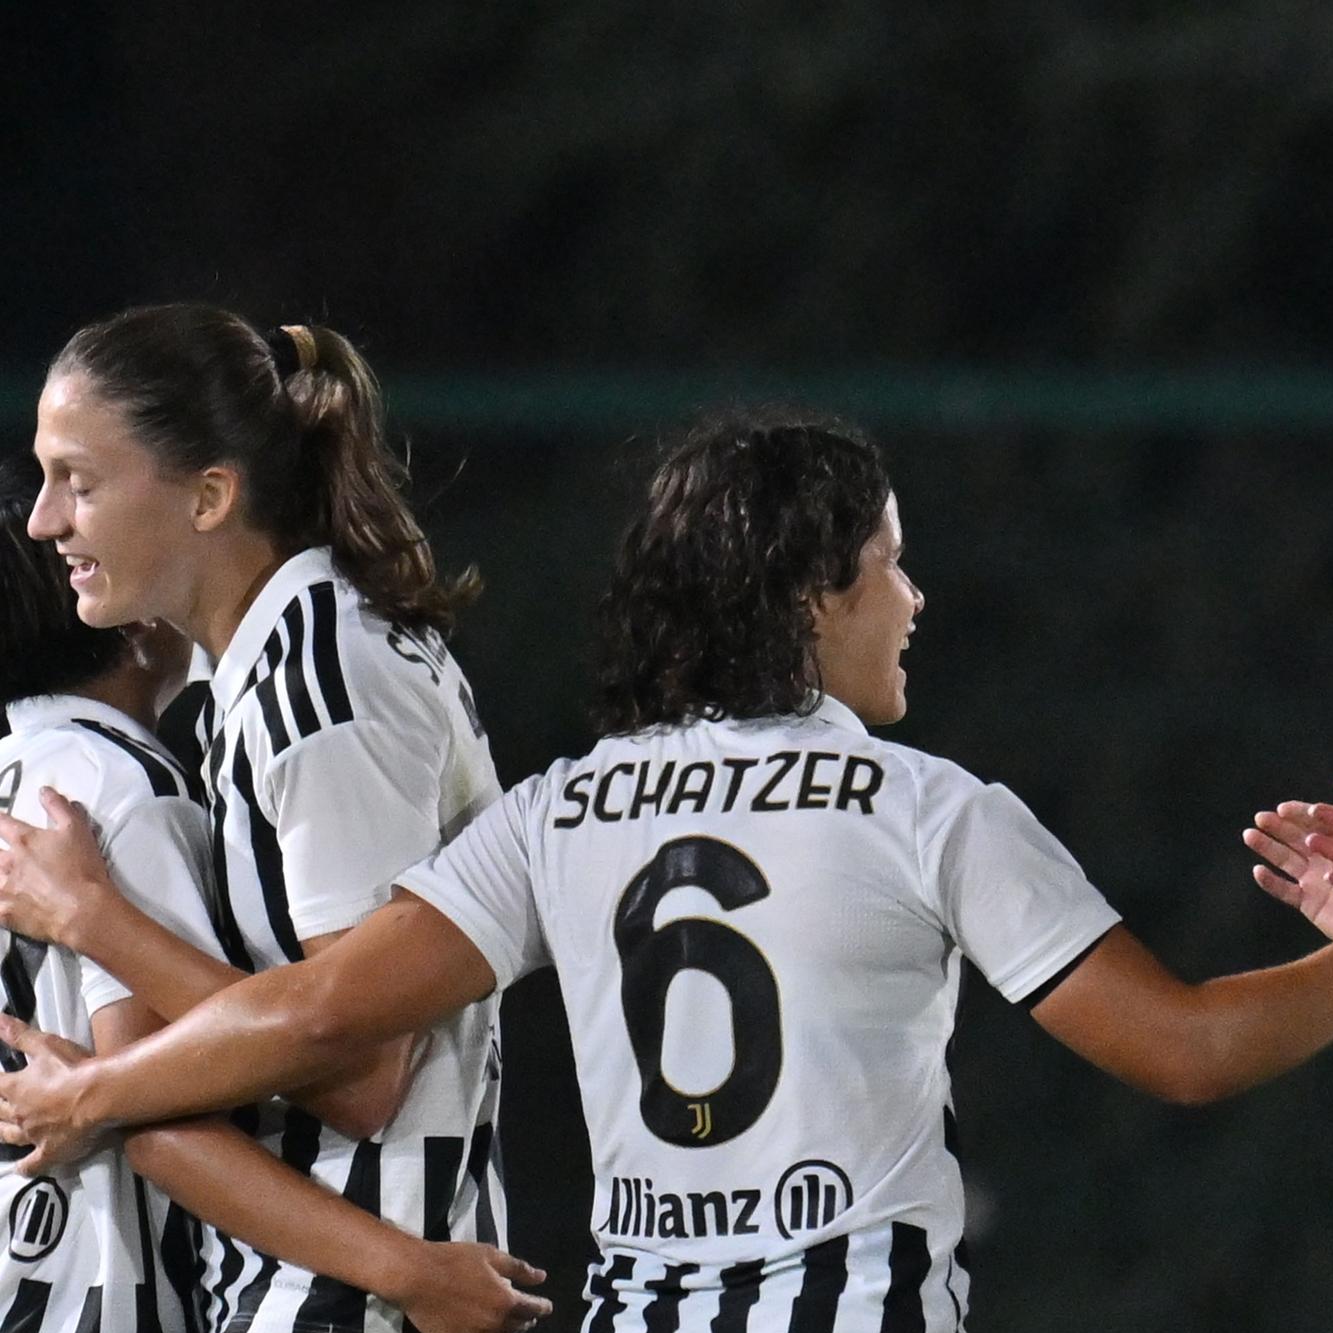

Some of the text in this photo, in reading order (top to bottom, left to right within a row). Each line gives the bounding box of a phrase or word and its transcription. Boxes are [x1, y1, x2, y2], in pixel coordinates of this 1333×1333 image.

[553, 751, 884, 829] SCHATZER
[613, 833, 784, 1149] 6
[598, 1175, 762, 1240] Allianz
